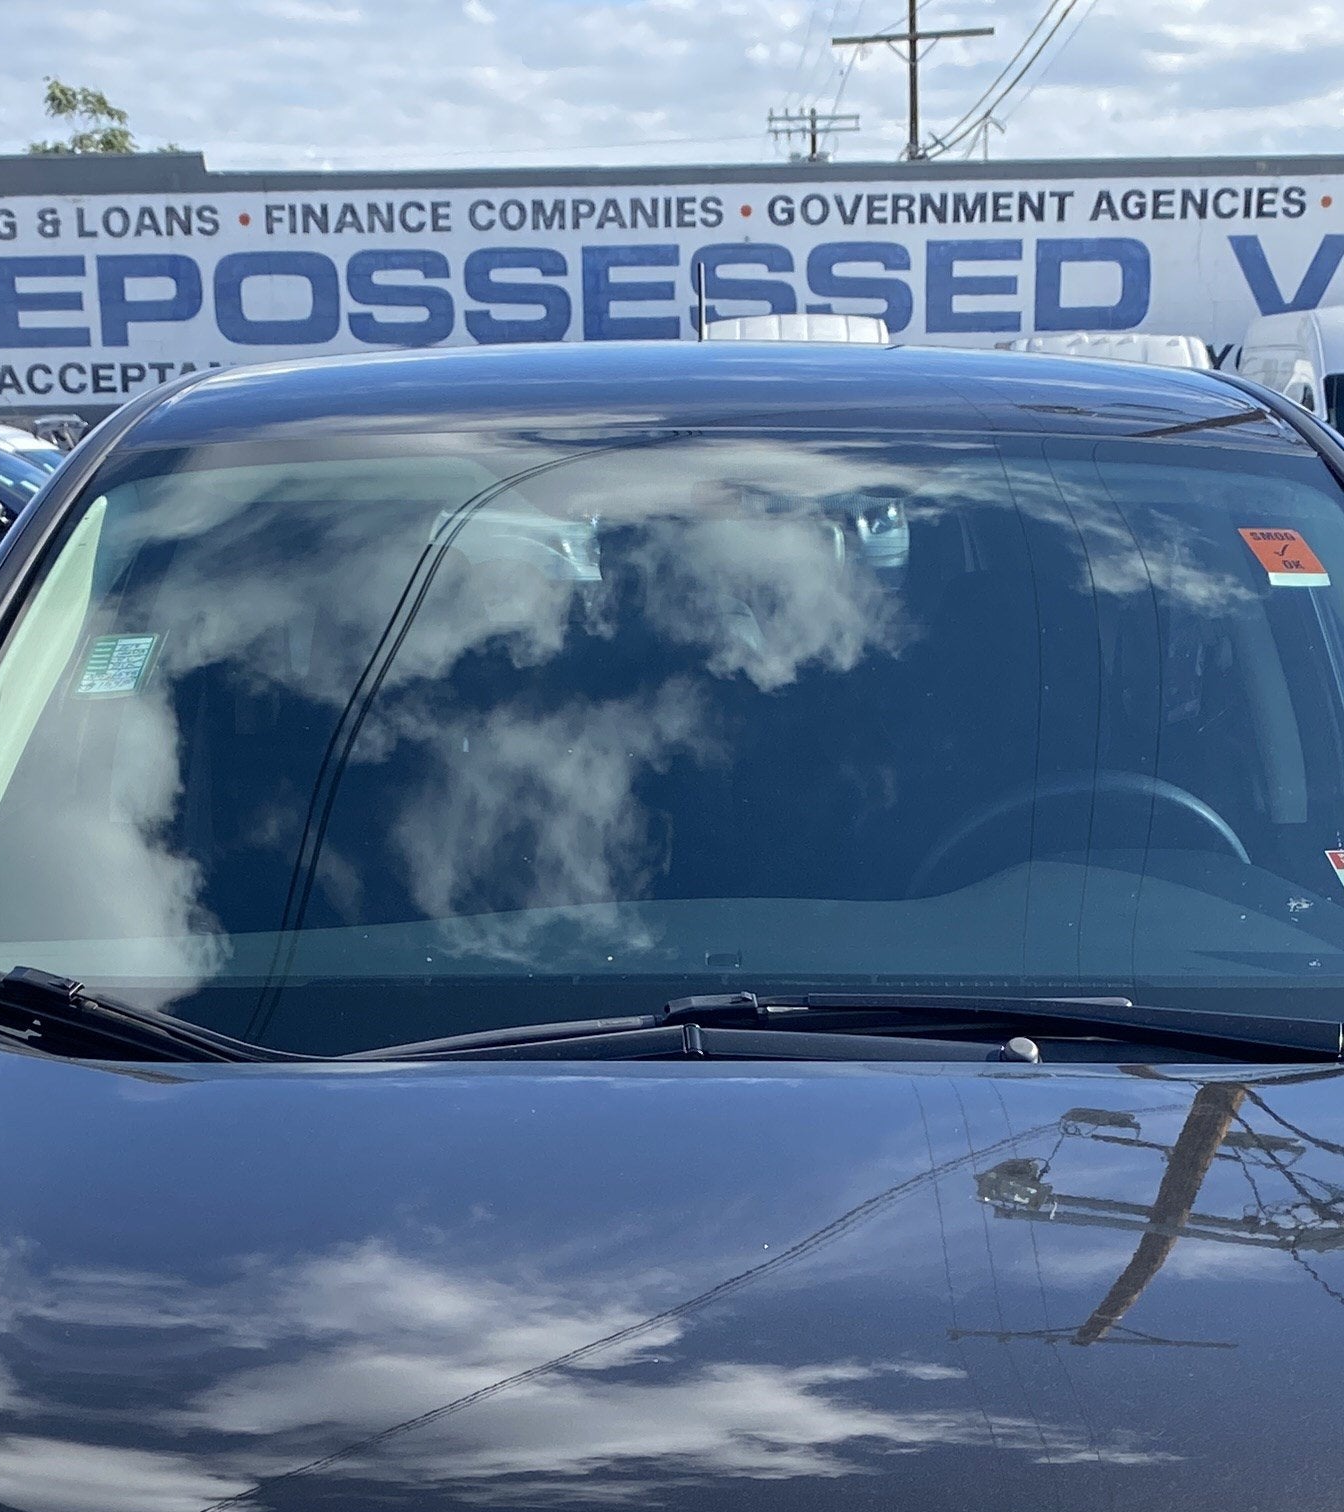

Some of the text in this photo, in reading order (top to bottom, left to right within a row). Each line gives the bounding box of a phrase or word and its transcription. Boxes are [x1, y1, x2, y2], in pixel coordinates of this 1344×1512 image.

[37, 208, 63, 239] &
[75, 204, 220, 239] LOANS
[264, 201, 452, 235] FINANCE
[467, 196, 724, 232] COMPANIES
[767, 189, 1075, 227] GOVERNMENT
[1089, 186, 1307, 221] AGENCIES
[1249, 531, 1297, 542] SMOG
